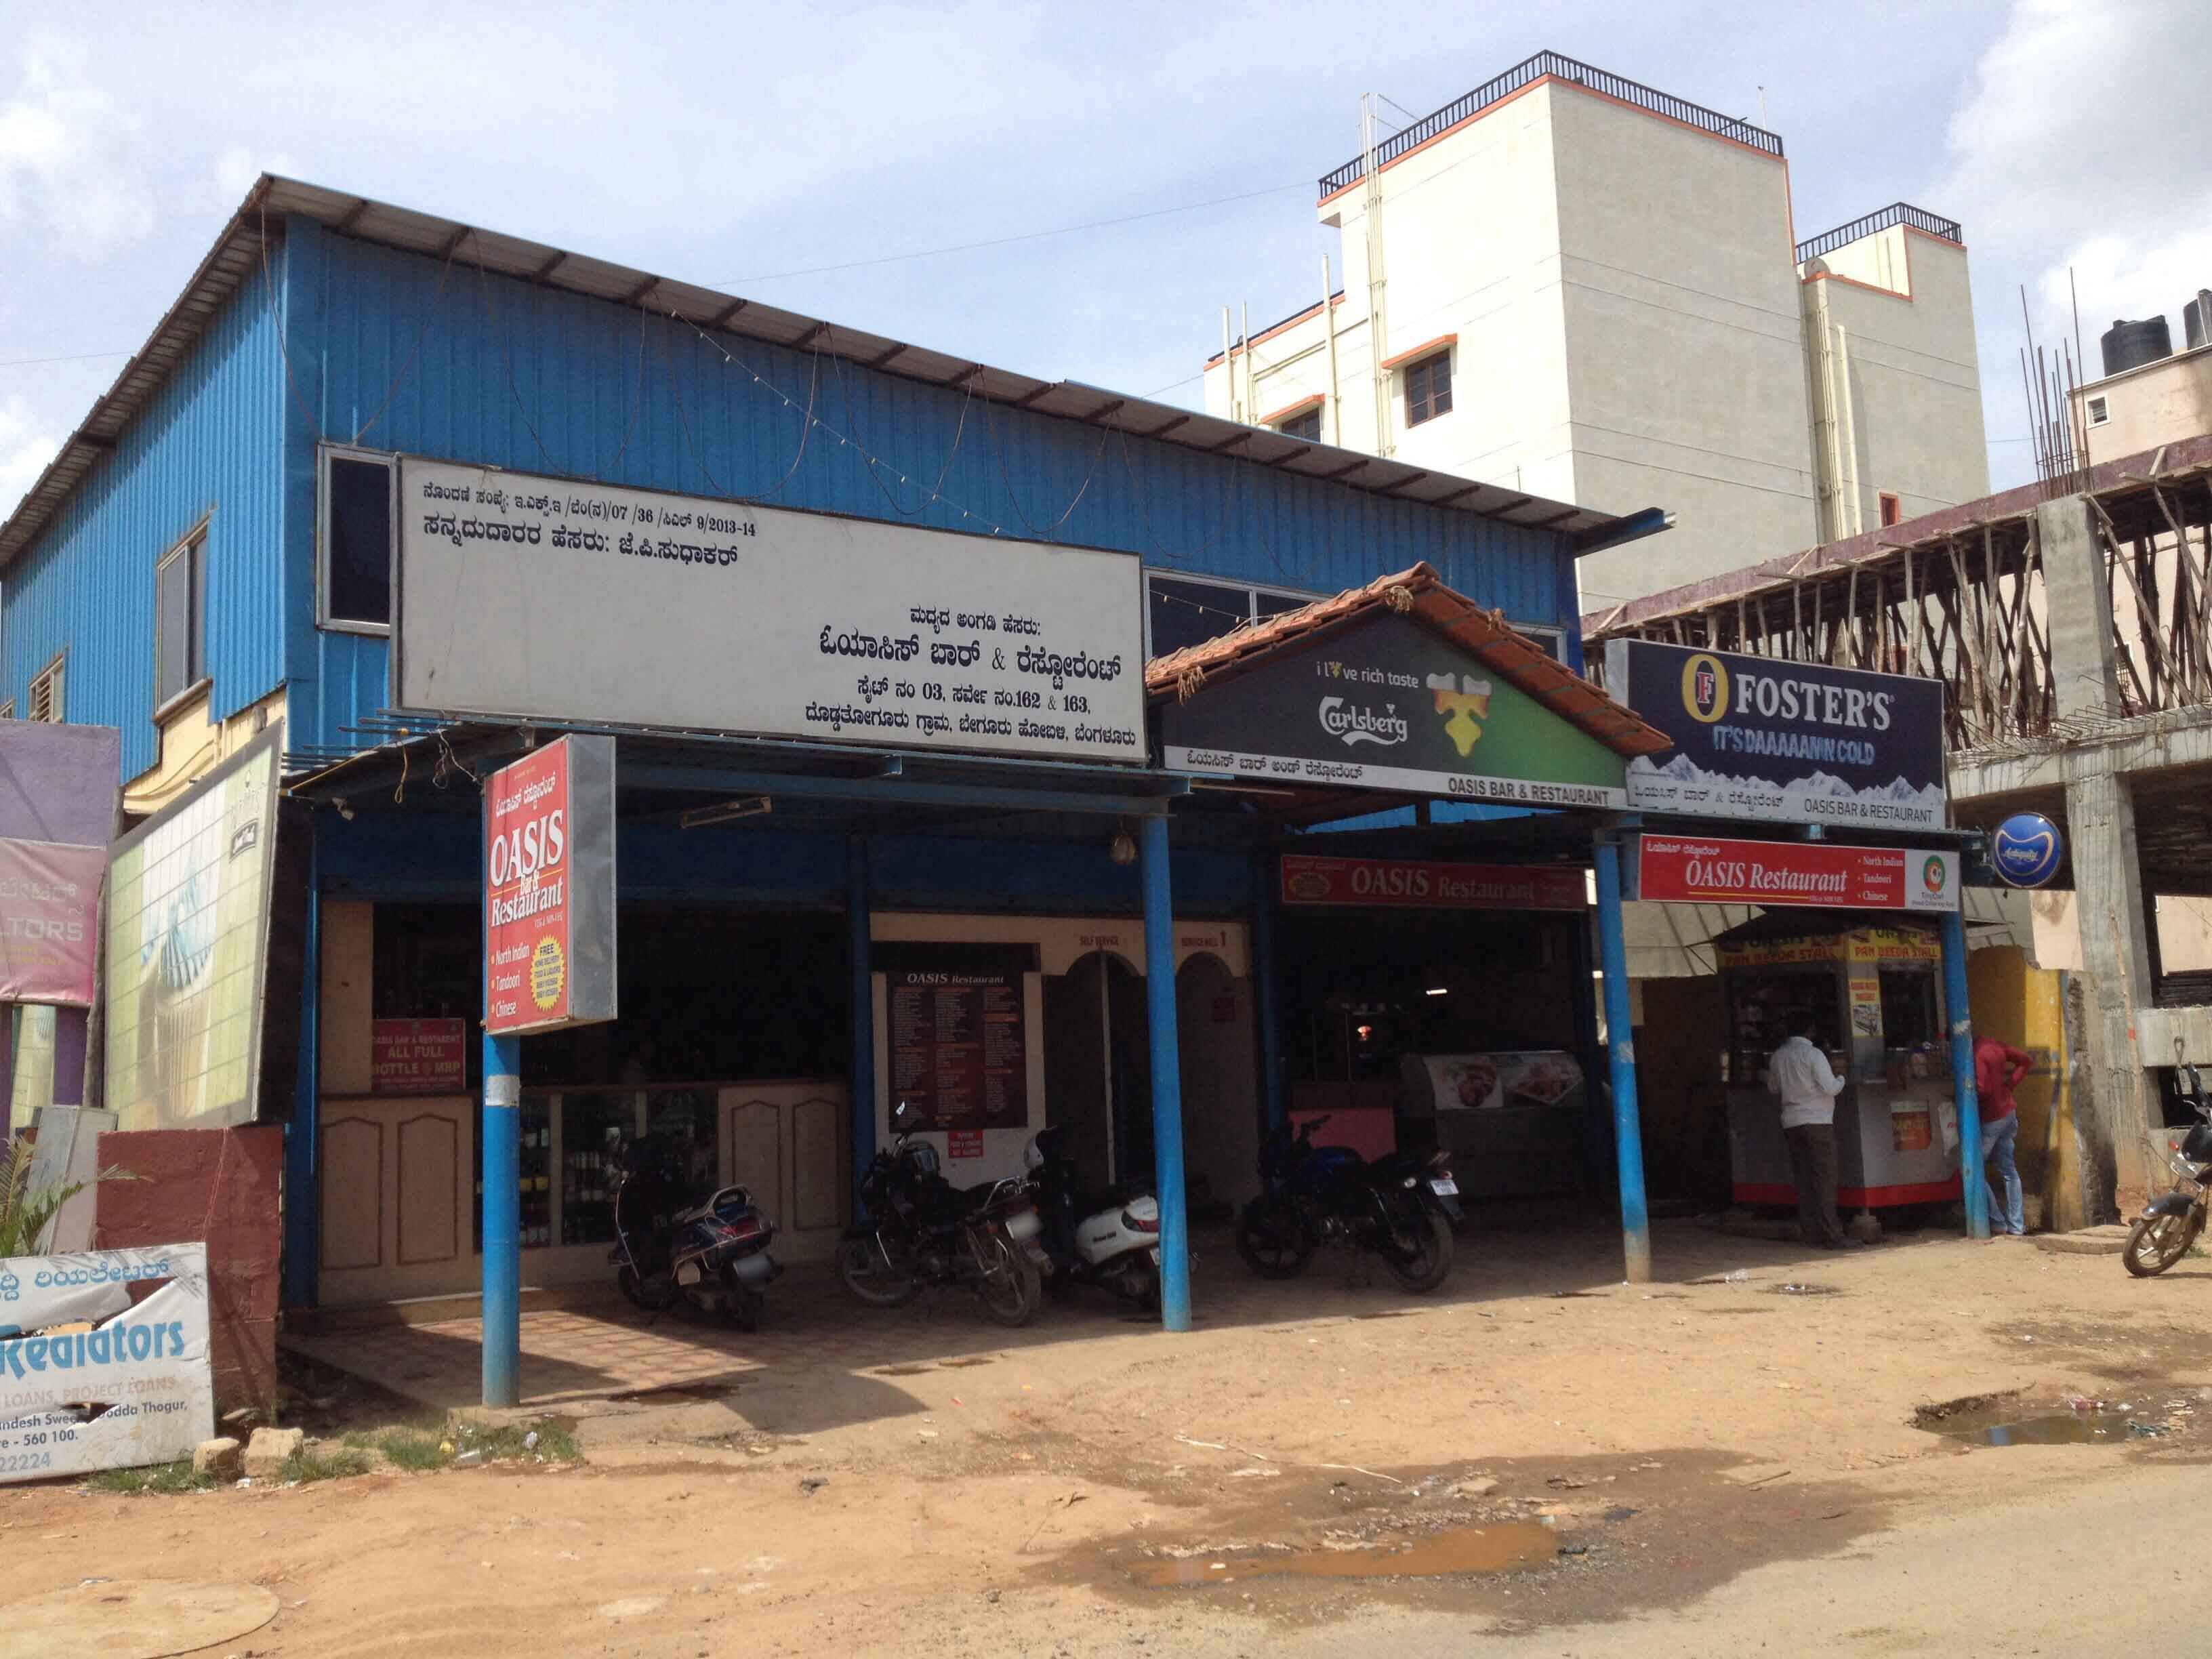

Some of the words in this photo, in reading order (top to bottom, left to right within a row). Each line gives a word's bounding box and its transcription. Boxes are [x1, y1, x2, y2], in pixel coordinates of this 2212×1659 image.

[697, 512, 756, 536] 9/2013-14
[910, 603, 950, 634] ಮದ್ಯದ
[957, 610, 996, 631] ಅಂಗಡಿ
[930, 640, 981, 667] ಬಾರ್
[992, 647, 1006, 670] &
[1017, 644, 1121, 691] ರೆಸ್ಟೋರೆಂಟ್
[1361, 668, 1384, 683] rich
[1388, 672, 1419, 688] taste
[857, 675, 888, 704] ಸೈಟ್
[895, 678, 915, 699] ನಂ
[1048, 695, 1057, 710] &
[1735, 674, 1891, 732] FOSTER'S
[960, 714, 1012, 735] ಬೇಗೂರು
[1075, 723, 1136, 745] ಬೆಂಗಳೂರು
[1319, 696, 1408, 745] Carlsberg
[1713, 724, 1744, 752] IT'S
[1837, 739, 1875, 765] COLD
[1448, 777, 1486, 796] OASIS
[1490, 781, 1515, 798] BAR
[1519, 783, 1528, 799] &
[1532, 785, 1610, 806] RESTAURANT
[1715, 792, 1724, 803] &
[1805, 798, 1835, 815] OASIS
[1838, 802, 1858, 817] BAR
[1860, 804, 1868, 818] &
[1870, 804, 1933, 823] RESTAURANT
[490, 809, 563, 887] OASIS
[1864, 856, 1880, 865] North
[1883, 857, 1904, 867] Indian
[1351, 867, 1430, 897] OASIS
[1438, 876, 1534, 900] Restaurant
[1685, 860, 1746, 888] OASIS
[1750, 863, 1848, 893] Restaurant
[1864, 873, 1891, 884] Tandoori
[491, 874, 563, 927] Restaurant
[1863, 890, 1888, 901] Chinese
[495, 947, 512, 966] North
[513, 943, 529, 960] Indian
[539, 943, 554, 956] FREE
[495, 970, 520, 991] Tandoori
[907, 972, 948, 983] OASIS
[951, 975, 1004, 983] Restaurant
[495, 998, 517, 1018] Chinese
[388, 1046, 410, 1058] ALL
[414, 1046, 445, 1058] FULL
[434, 1062, 461, 1075] MRP
[64, 1384, 123, 1401] PROJECT
[23, 1433, 47, 1447] 560
[52, 1430, 79, 1443] 100.
